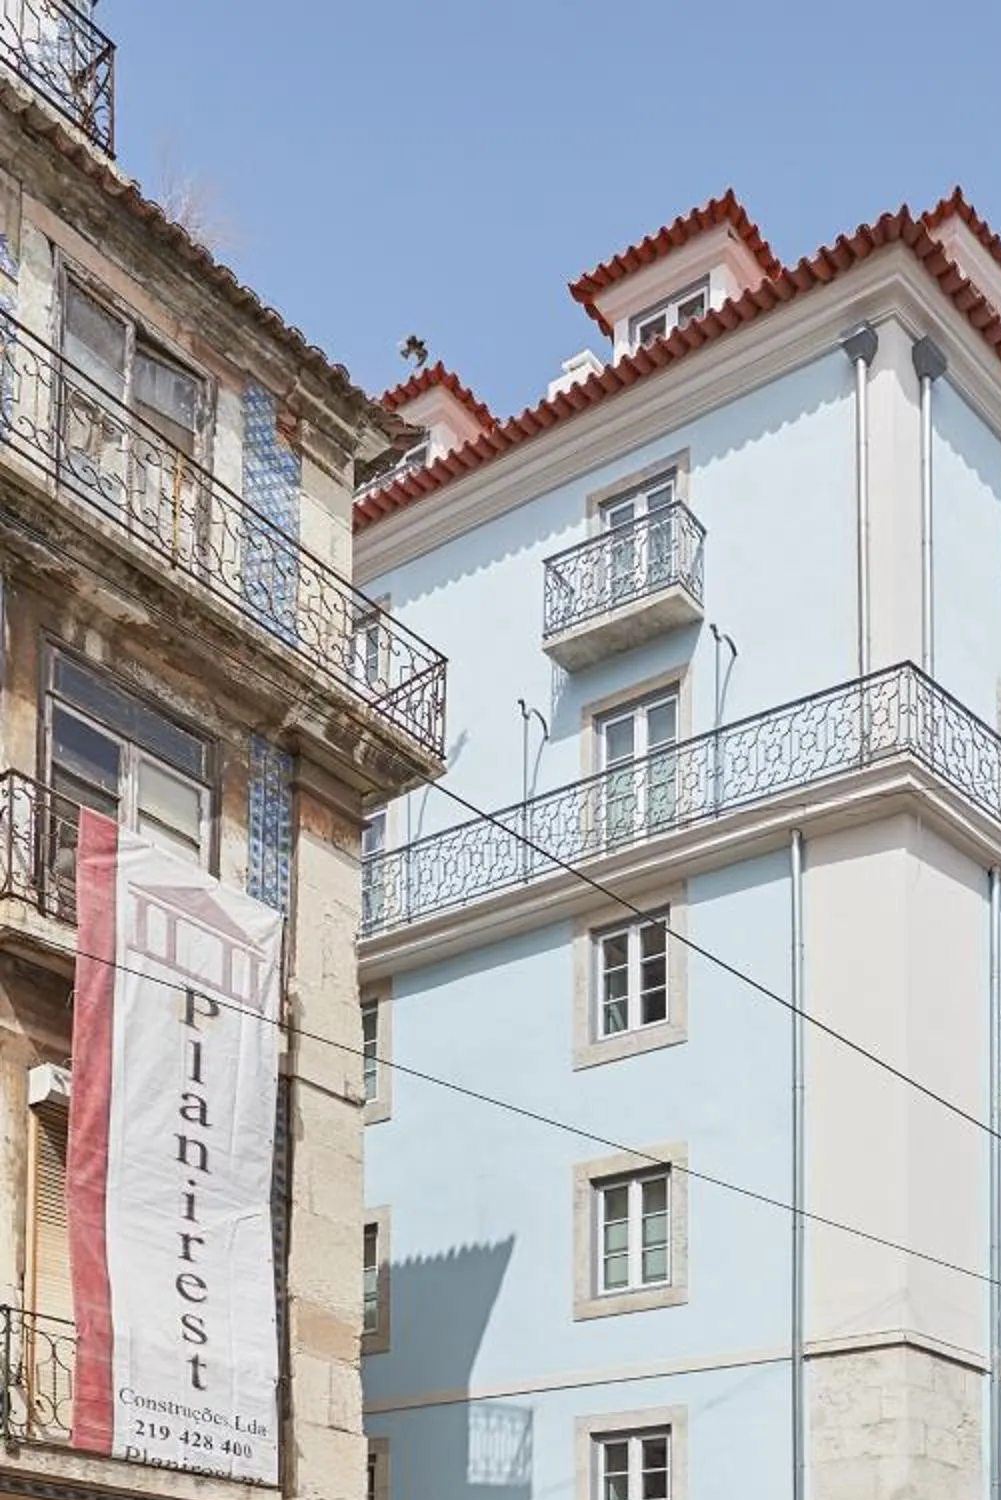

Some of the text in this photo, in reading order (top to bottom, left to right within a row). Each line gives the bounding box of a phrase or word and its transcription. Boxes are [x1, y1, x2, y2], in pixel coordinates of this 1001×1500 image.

[174, 984, 220, 1391] Planirest
[135, 1419, 252, 1459] 219 428 400
